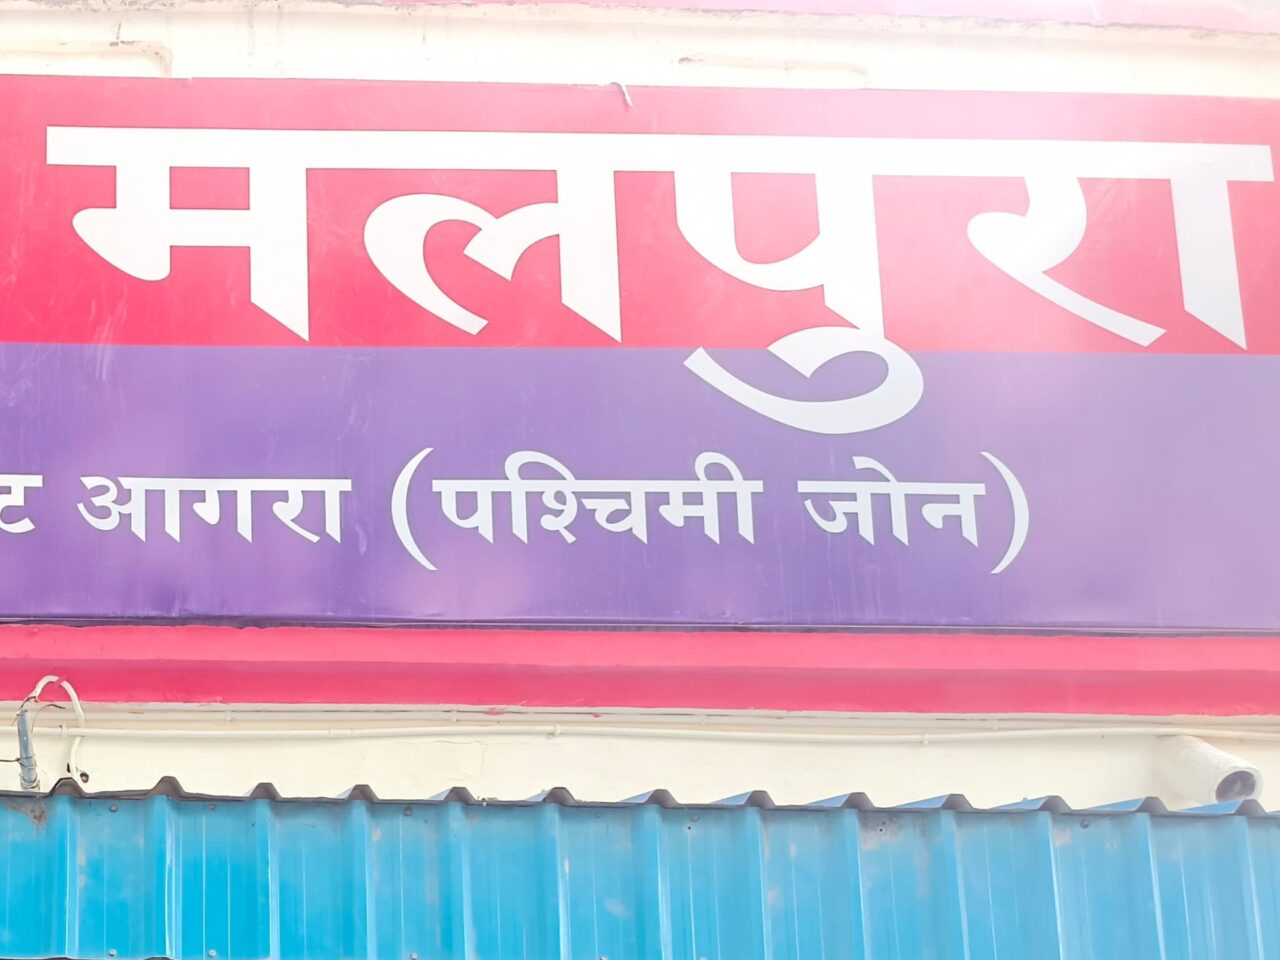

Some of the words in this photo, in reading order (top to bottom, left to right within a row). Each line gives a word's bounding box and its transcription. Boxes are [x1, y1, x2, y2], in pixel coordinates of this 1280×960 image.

[45, 126, 1275, 434] मलपुरा
[76, 475, 353, 544] आगरा
[391, 447, 765, 572] (पश्चिमी
[797, 450, 1033, 574] जोन)
